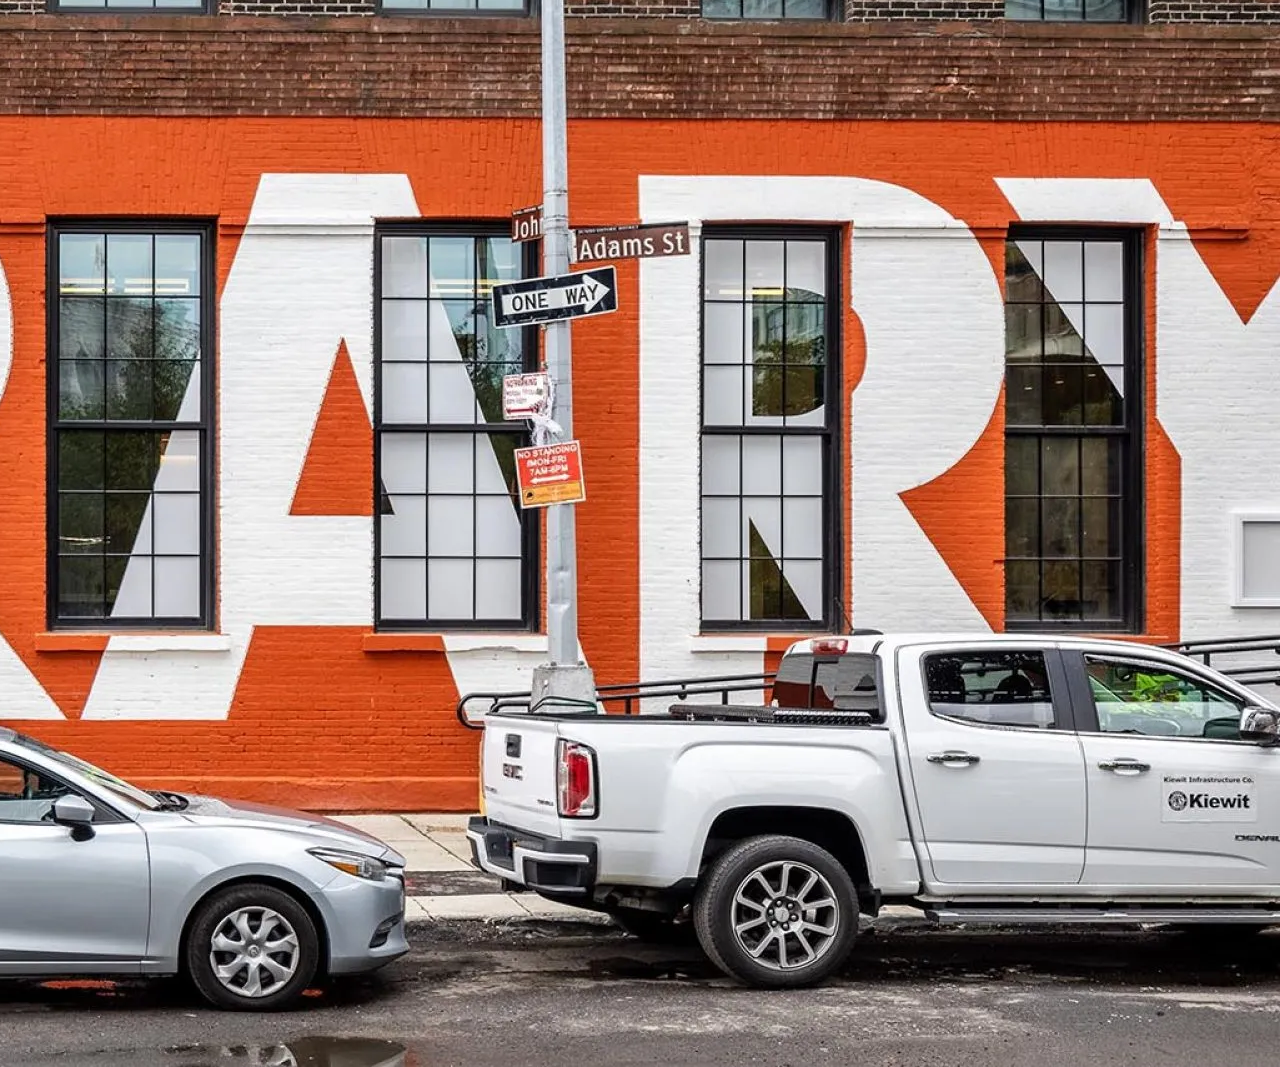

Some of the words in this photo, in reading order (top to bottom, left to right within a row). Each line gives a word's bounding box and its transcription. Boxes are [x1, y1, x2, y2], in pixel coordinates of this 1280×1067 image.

[579, 236, 654, 261] Adams
[662, 231, 685, 254] St
[511, 292, 549, 312] ONE
[565, 284, 599, 305] WAY
[518, 450, 531, 459] NO
[532, 444, 577, 457] STANDING
[1242, 776, 1255, 784] Co.
[1189, 794, 1251, 809] Kiewit
